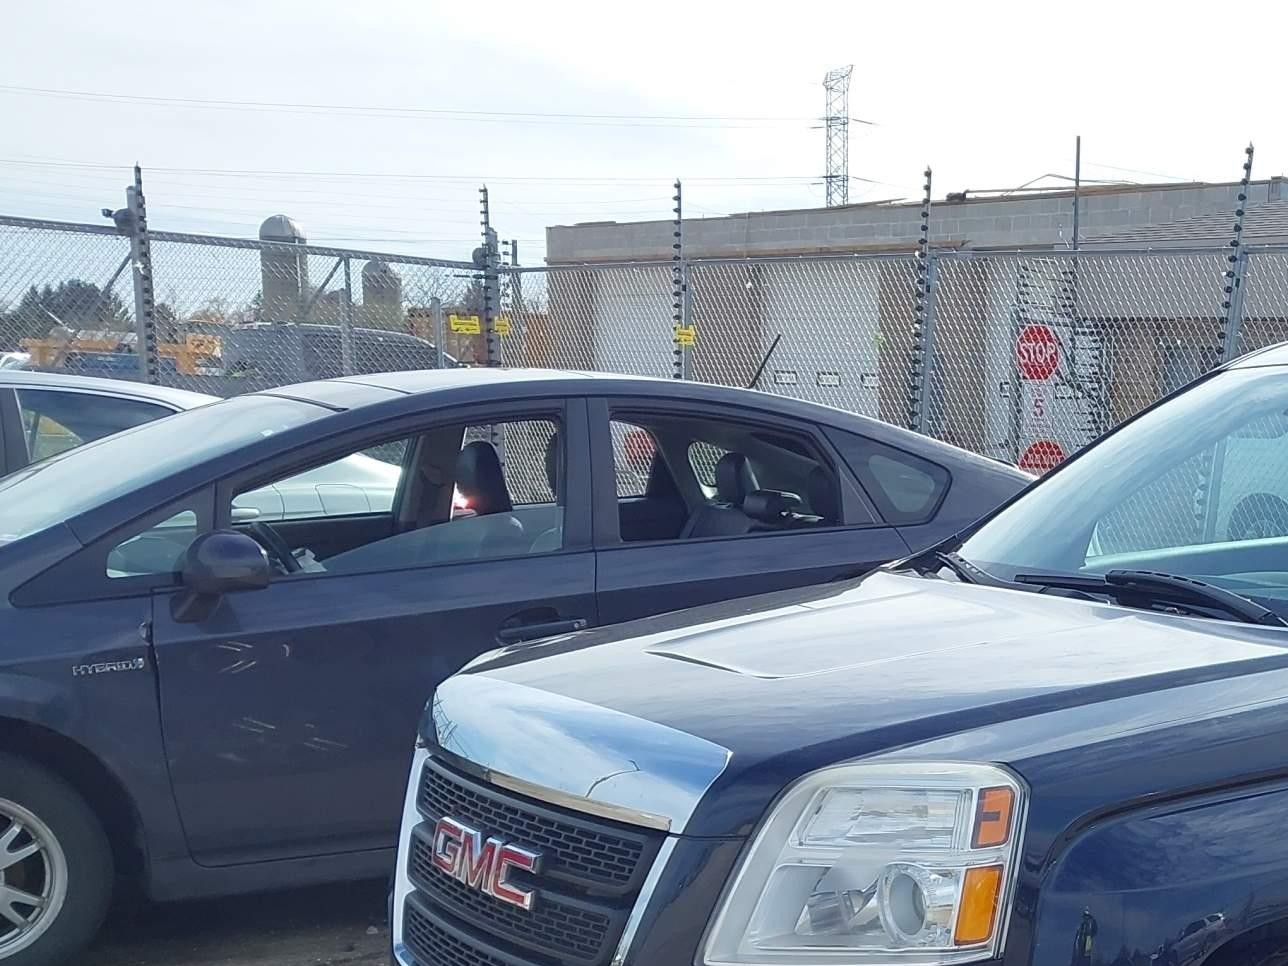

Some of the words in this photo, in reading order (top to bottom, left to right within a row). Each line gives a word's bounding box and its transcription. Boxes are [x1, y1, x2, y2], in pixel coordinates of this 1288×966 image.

[1020, 343, 1055, 363] STOP
[72, 660, 132, 676] HYBRID
[431, 816, 543, 910] GMC
